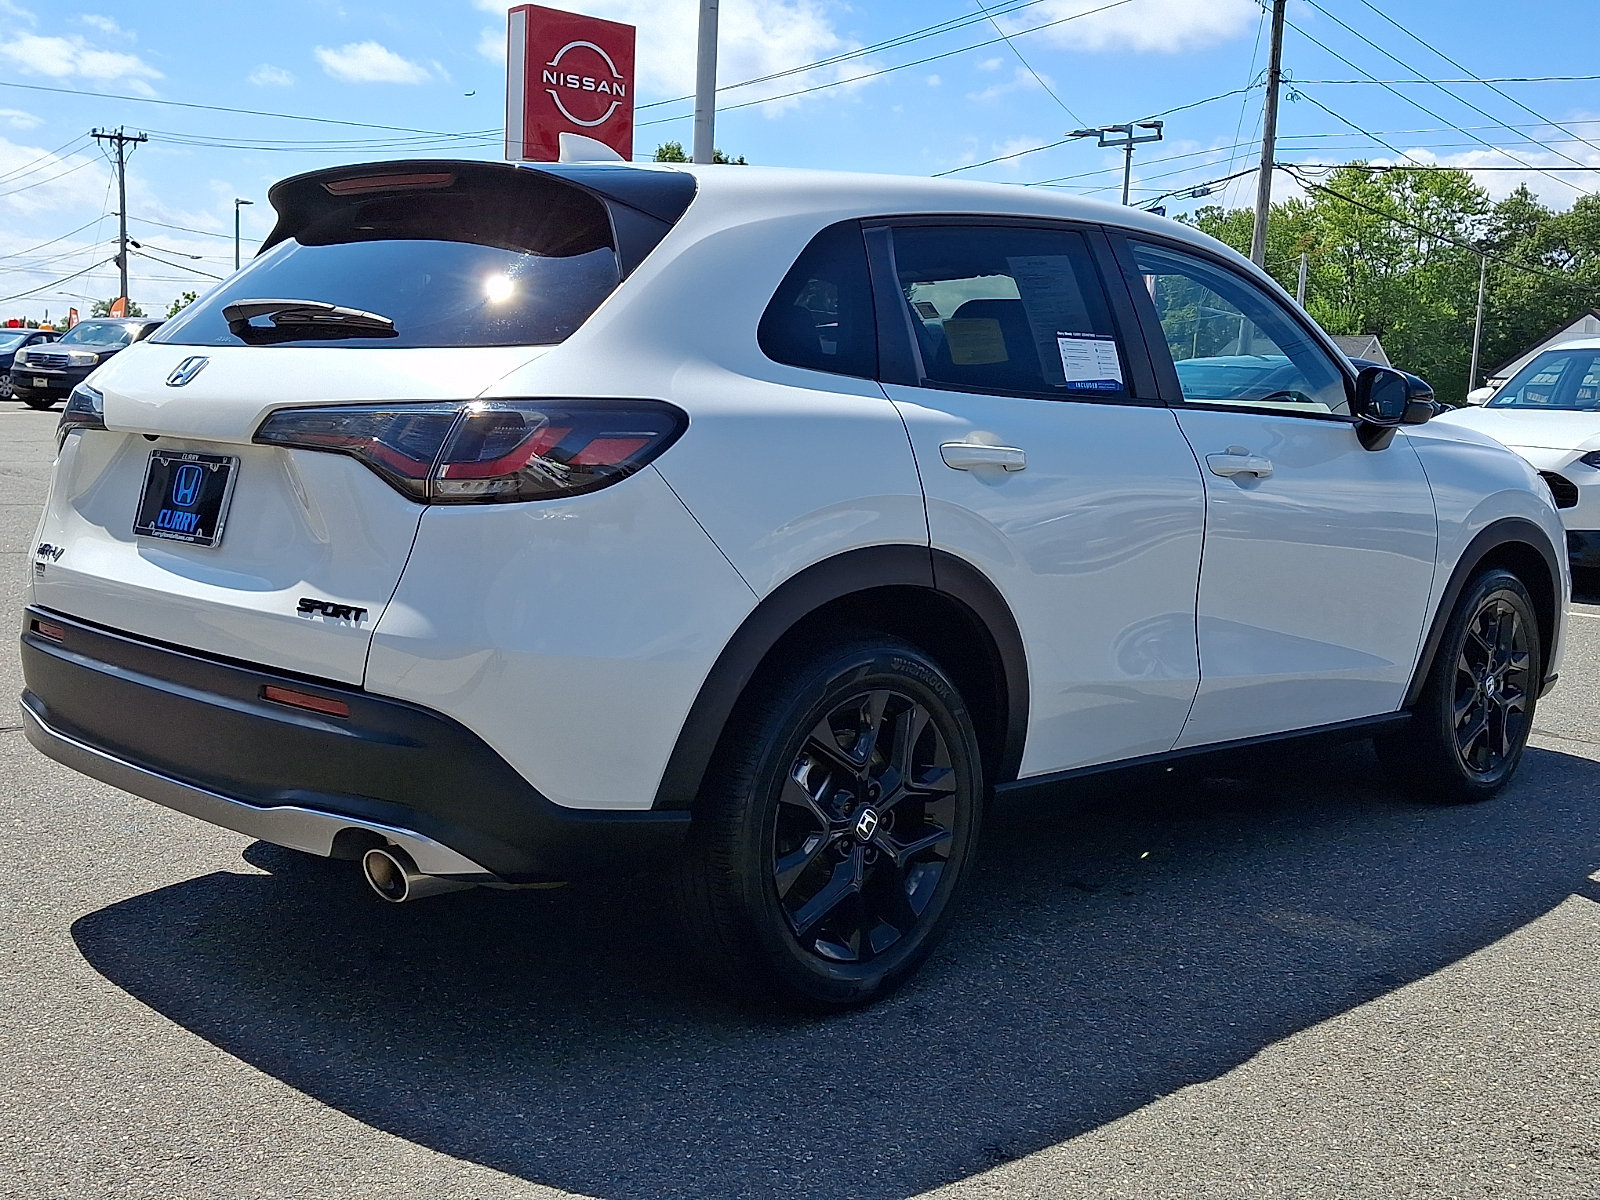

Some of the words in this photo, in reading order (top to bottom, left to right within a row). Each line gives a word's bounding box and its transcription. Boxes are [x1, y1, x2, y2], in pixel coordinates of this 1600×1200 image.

[542, 69, 626, 97] NISSAN
[157, 508, 201, 532] CURRY
[296, 597, 368, 621] SPORT
